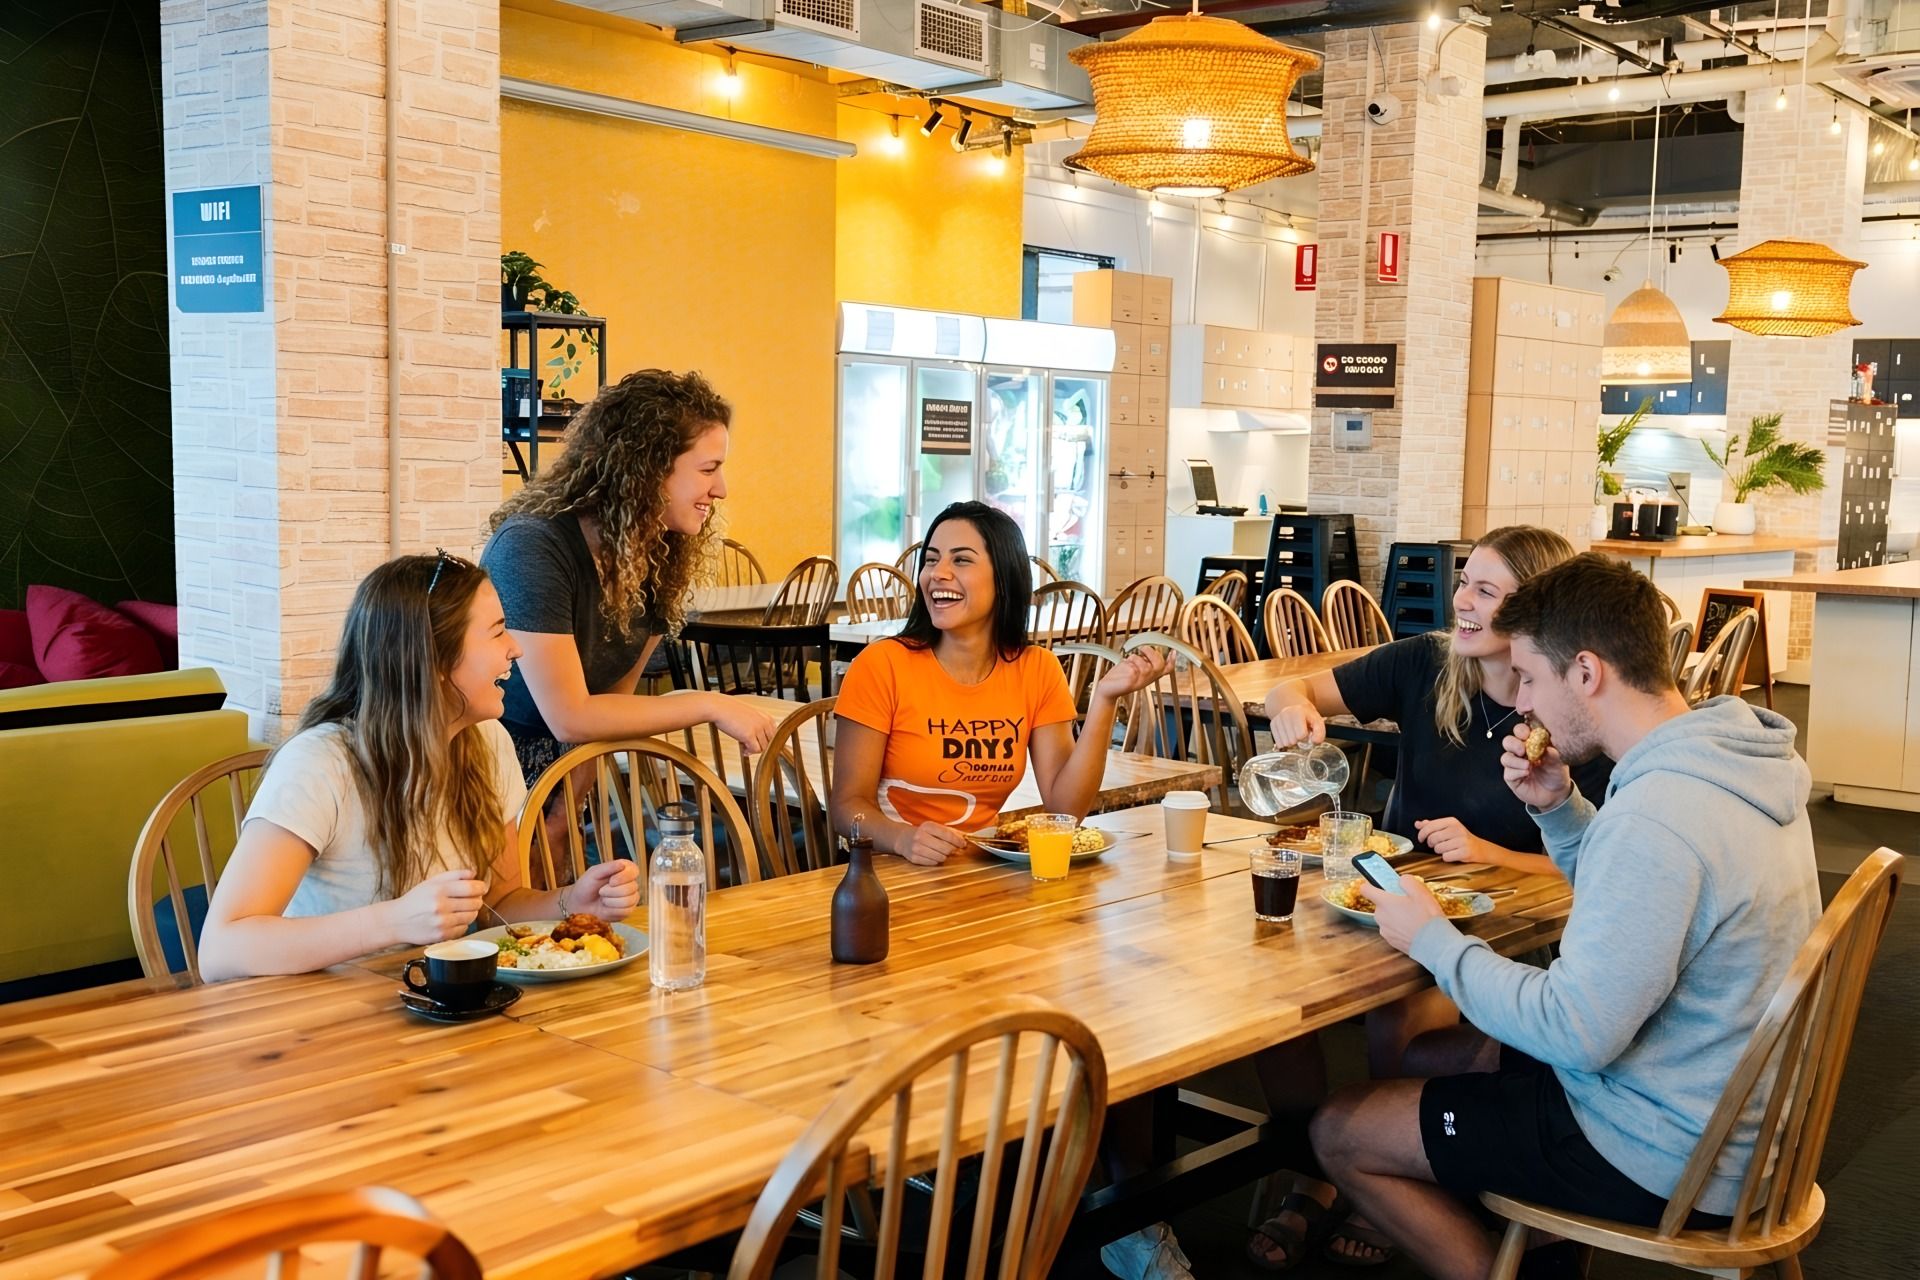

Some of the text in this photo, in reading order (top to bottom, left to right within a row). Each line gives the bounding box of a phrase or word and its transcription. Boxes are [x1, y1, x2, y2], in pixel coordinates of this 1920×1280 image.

[200, 201, 231, 222] WIFI
[927, 717, 1024, 743] HAPPY
[942, 737, 1015, 759] DAYS
